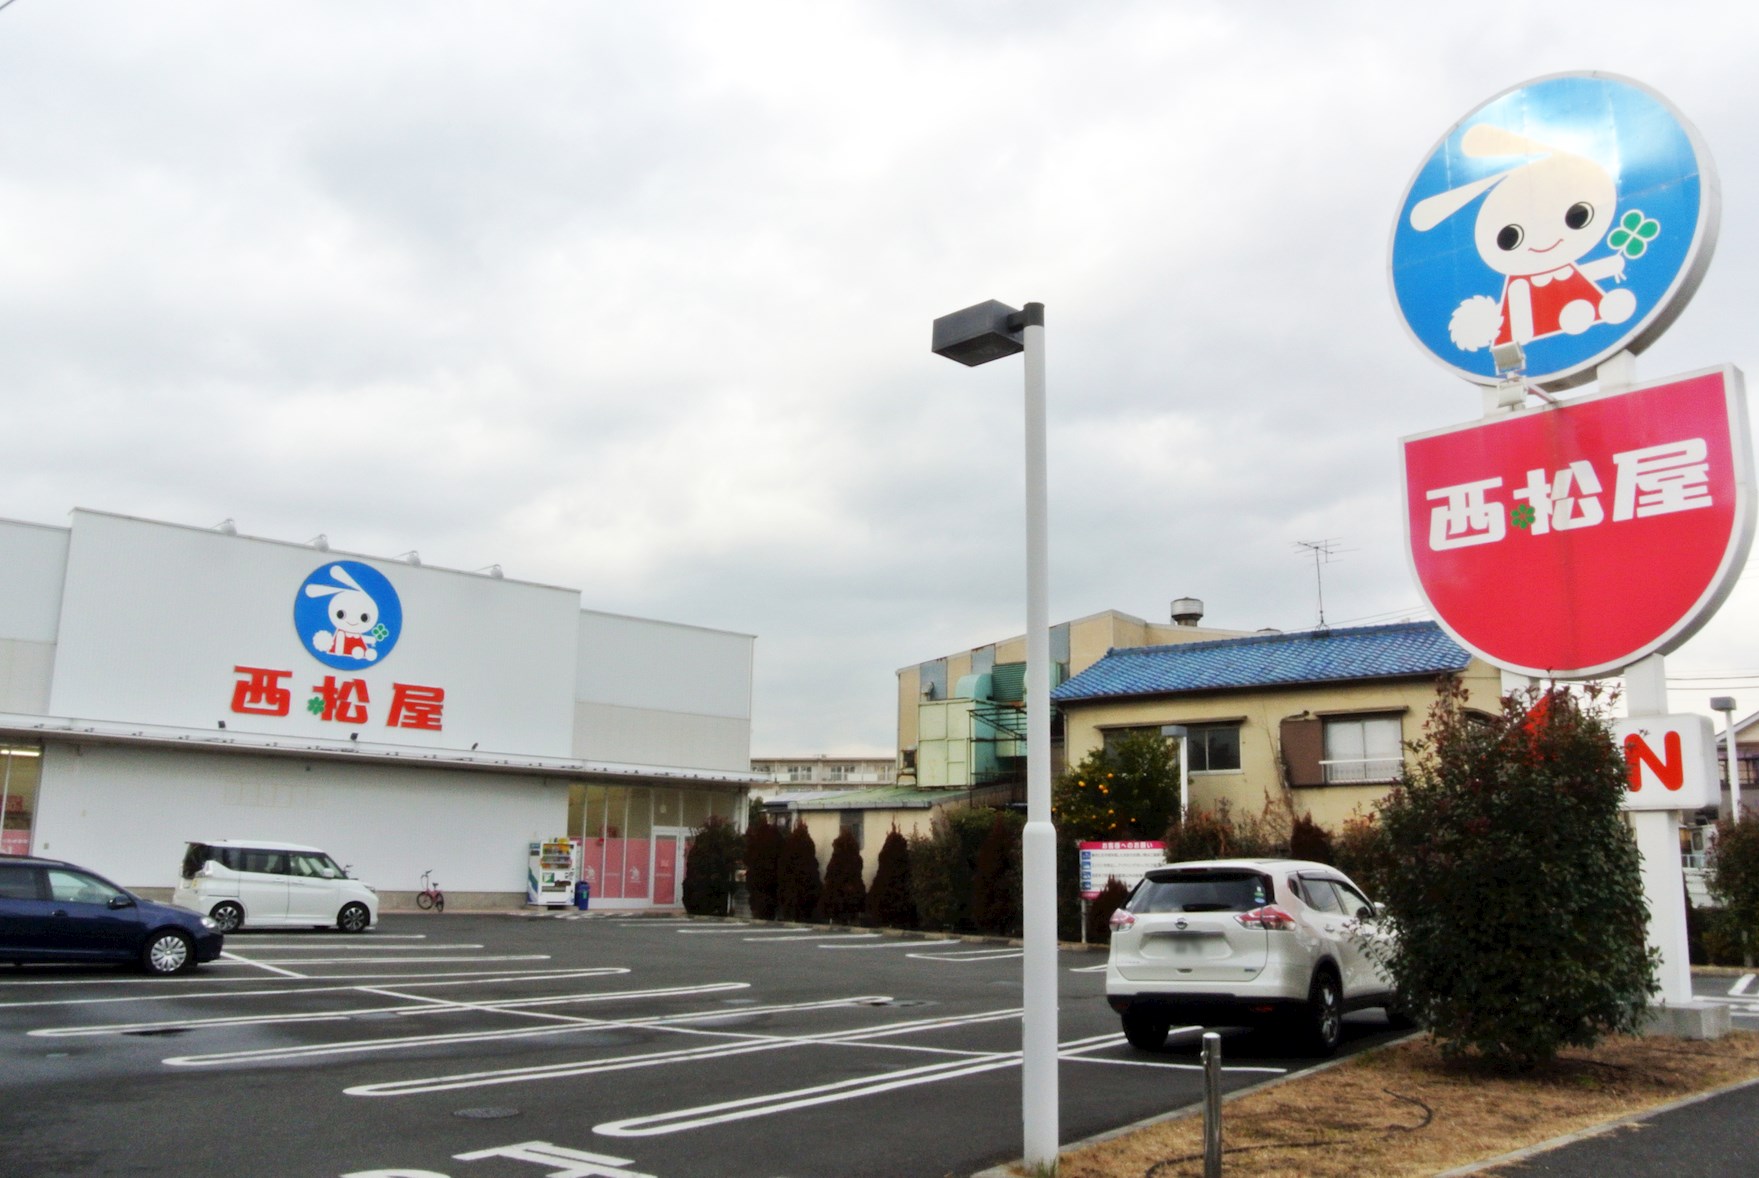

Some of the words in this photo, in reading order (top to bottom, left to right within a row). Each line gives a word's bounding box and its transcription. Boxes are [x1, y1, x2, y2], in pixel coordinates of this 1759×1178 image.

[1427, 438, 1713, 552] 西松屋
[231, 666, 445, 731] 西松屋
